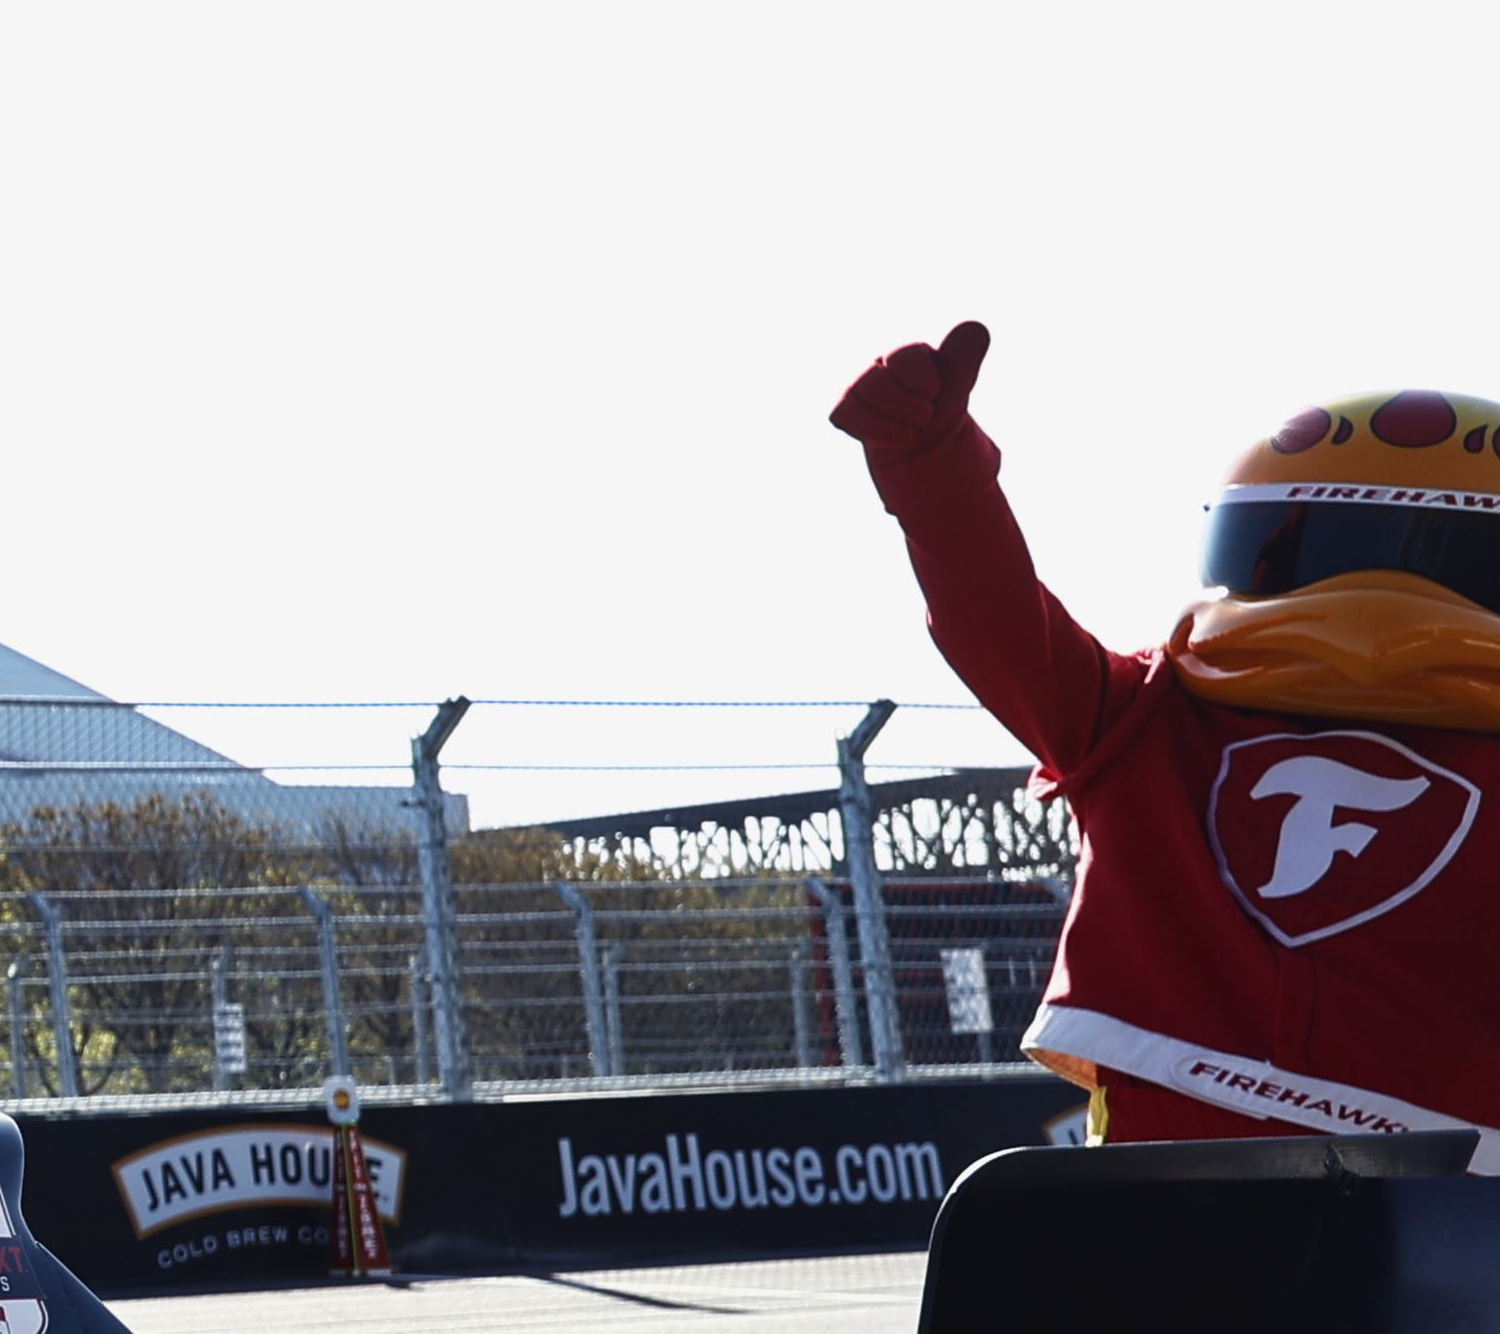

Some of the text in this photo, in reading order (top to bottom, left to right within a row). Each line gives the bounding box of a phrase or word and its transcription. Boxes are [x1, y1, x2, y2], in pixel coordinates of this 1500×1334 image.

[141, 1147, 236, 1212] JAVA
[557, 1132, 944, 1218] JavaHouse.com
[157, 1234, 219, 1269] COLD
[226, 1225, 290, 1249] BREW
